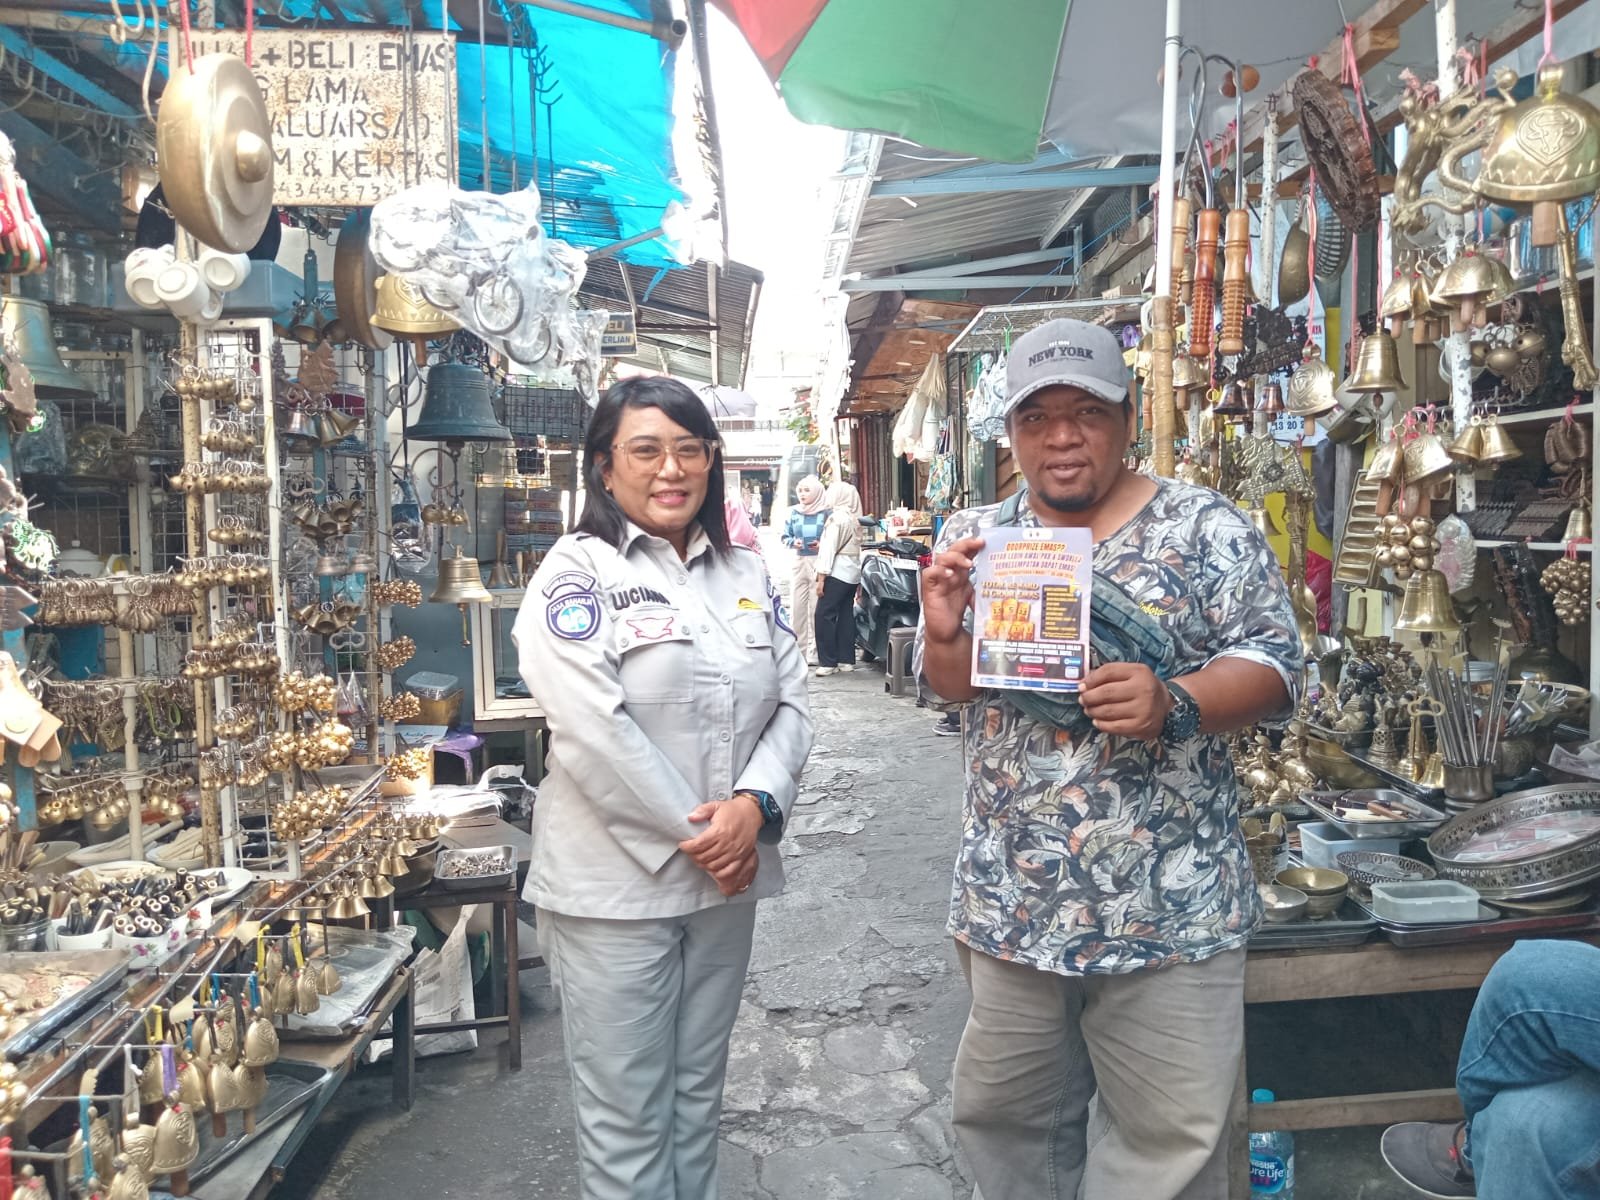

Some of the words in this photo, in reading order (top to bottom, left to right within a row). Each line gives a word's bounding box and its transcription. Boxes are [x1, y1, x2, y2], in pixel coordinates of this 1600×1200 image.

[379, 41, 456, 72] EMAS
[284, 76, 369, 104] LAMA
[332, 150, 450, 180] KERTAS
[1028, 347, 1057, 367] NEW
[1058, 346, 1094, 360] YORK
[1287, 420, 1297, 430] 20
[1250, 1168, 1266, 1177] ure
[1266, 1168, 1285, 1182] Life
